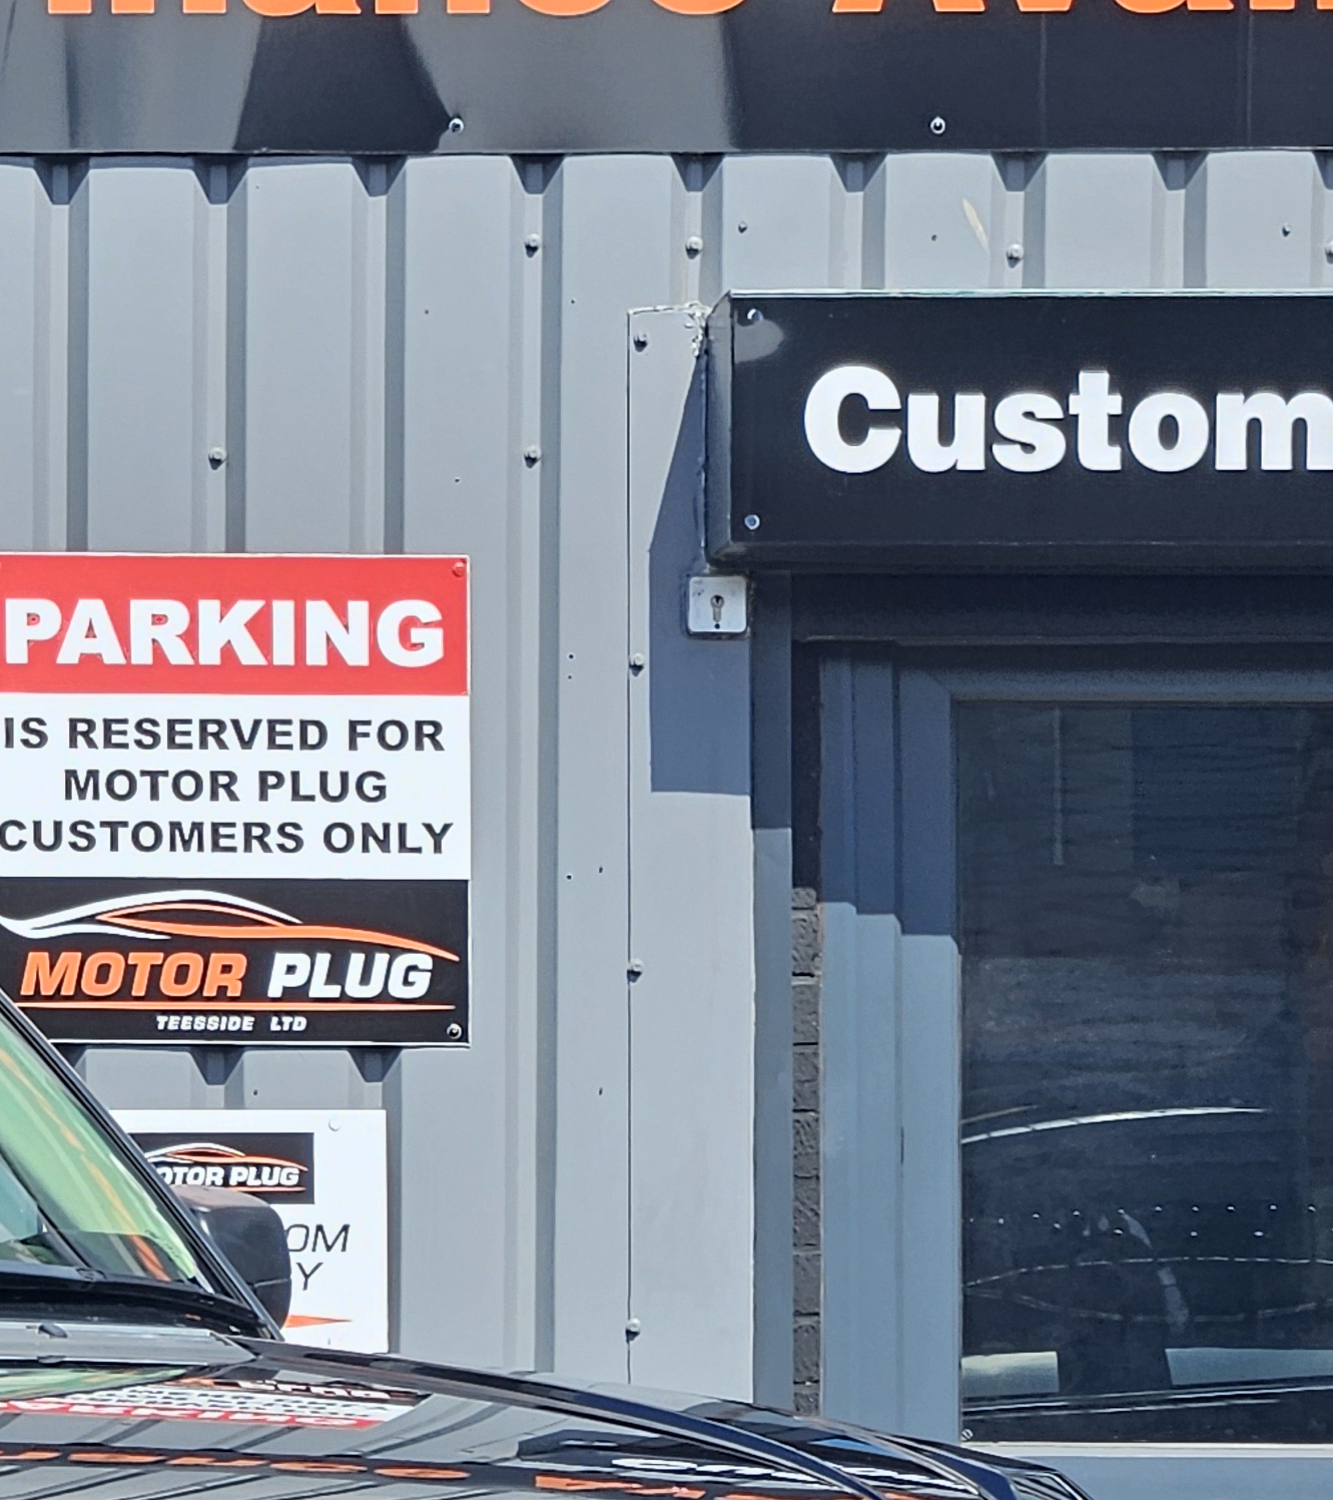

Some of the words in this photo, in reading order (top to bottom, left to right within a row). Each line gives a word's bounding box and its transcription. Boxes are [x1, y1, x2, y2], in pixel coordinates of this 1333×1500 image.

[804, 365, 1333, 474] Custom
[5, 598, 444, 668] PARKING
[4, 717, 48, 750] IS
[68, 717, 328, 751] RESERVED
[348, 719, 445, 751] FOR
[64, 769, 240, 802] MOTOR
[258, 770, 388, 803] PLUG
[323, 822, 453, 854] ONLY
[20, 952, 247, 997] MOTOR
[267, 952, 433, 999] PLUG
[155, 1015, 255, 1032] TEESSIDE
[270, 1015, 308, 1033] LTD
[156, 1166, 225, 1186] OTOR
[229, 1166, 300, 1187] PLUG
